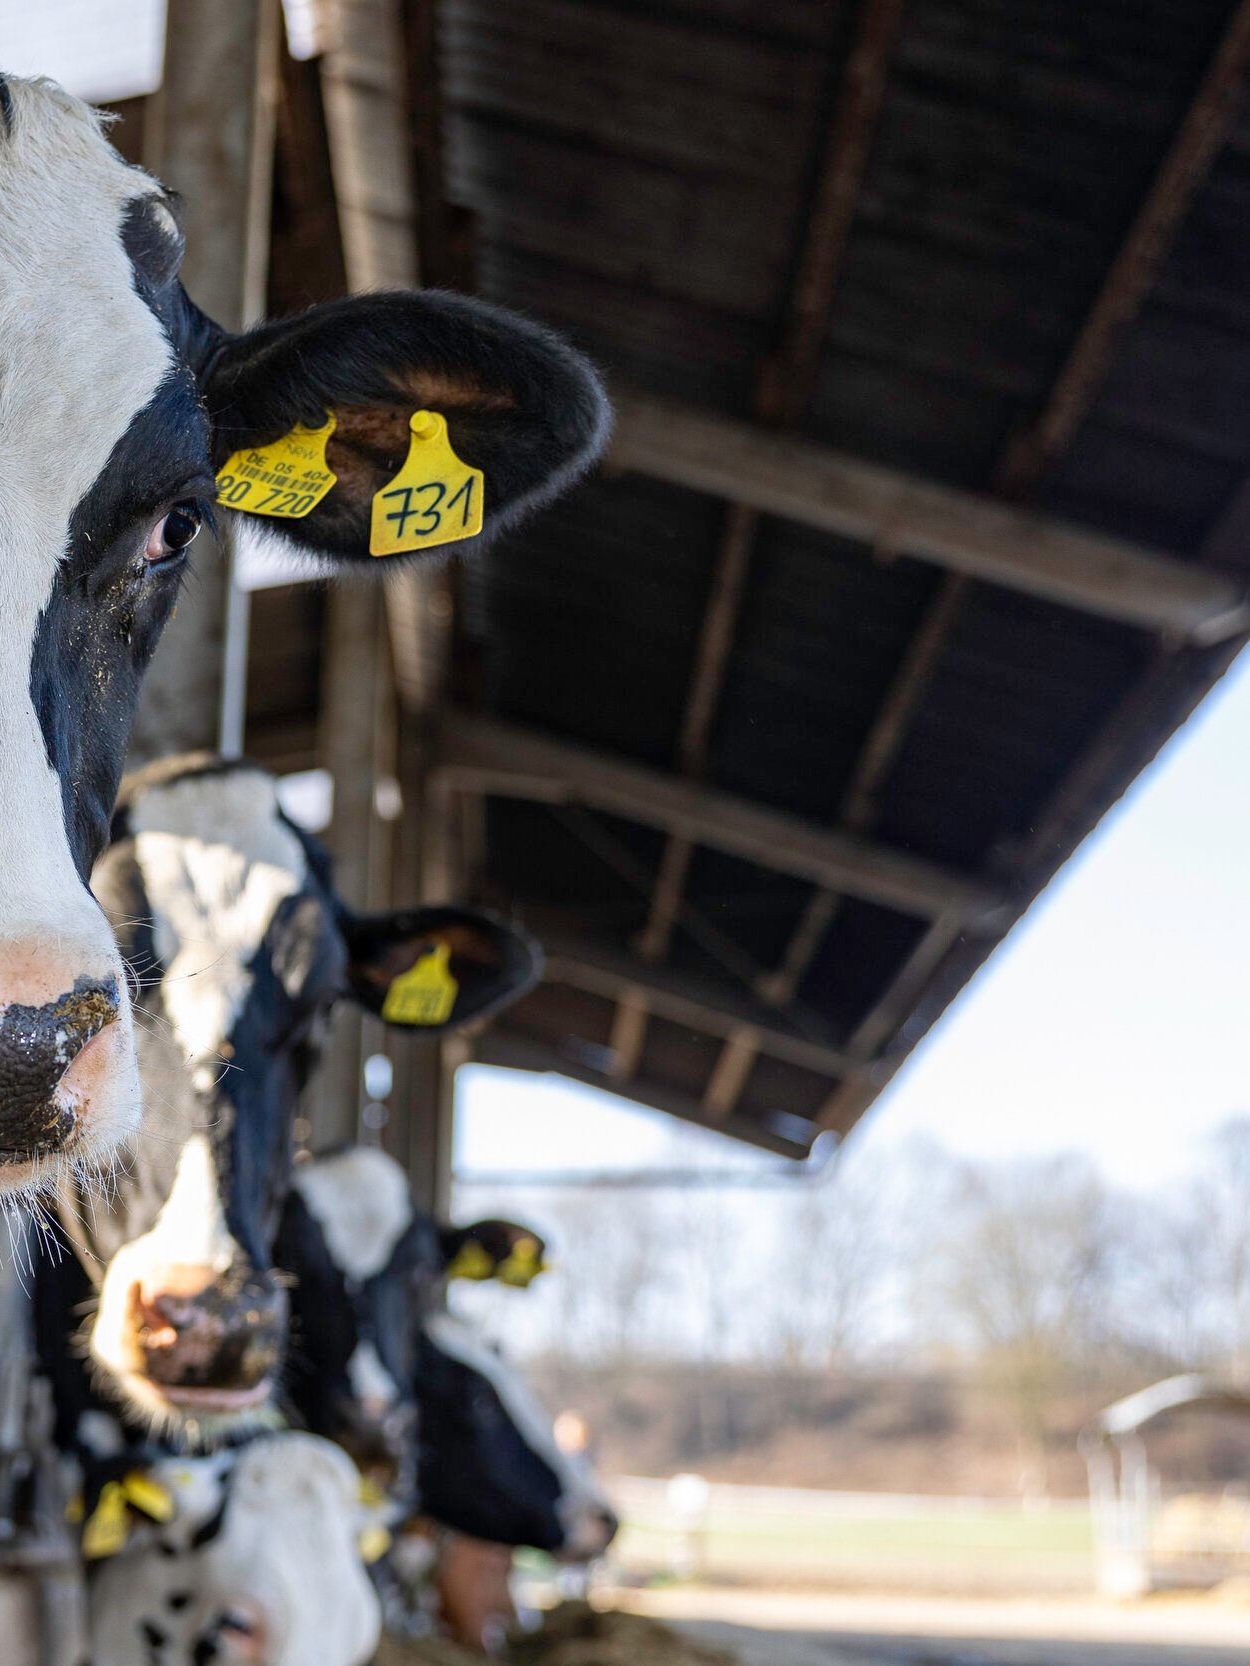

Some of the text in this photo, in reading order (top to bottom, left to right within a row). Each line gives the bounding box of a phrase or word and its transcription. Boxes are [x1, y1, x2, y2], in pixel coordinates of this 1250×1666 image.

[246, 452, 331, 482] DE 05 404
[254, 488, 315, 515] 720
[382, 475, 475, 538] 731
